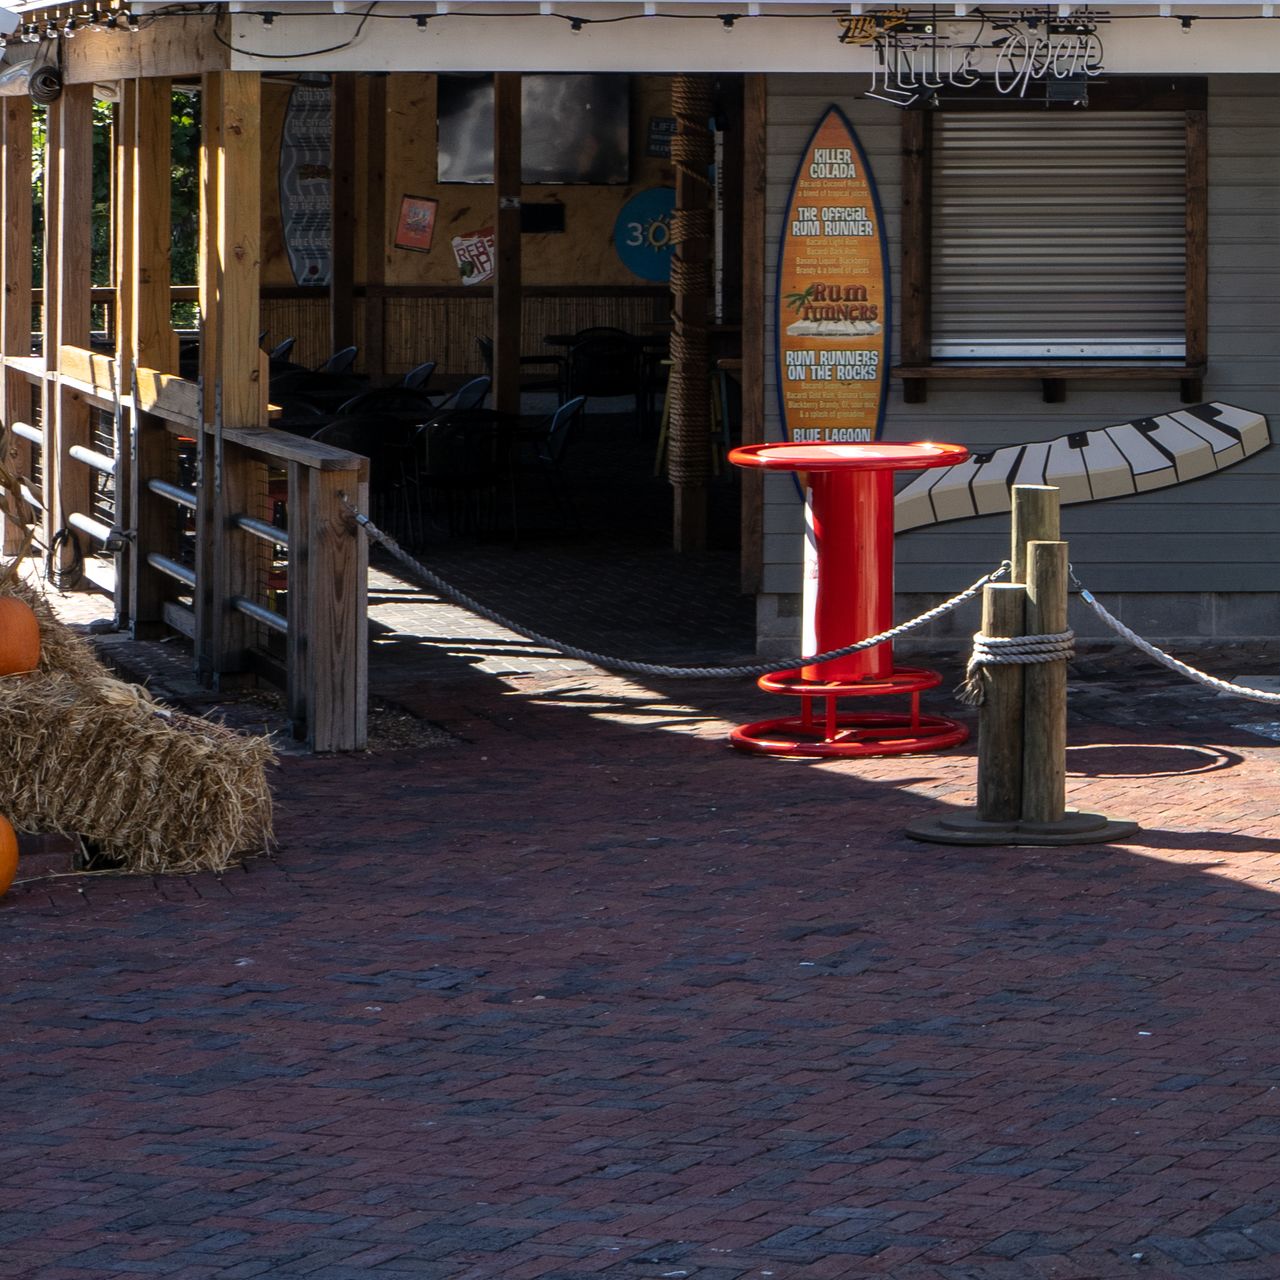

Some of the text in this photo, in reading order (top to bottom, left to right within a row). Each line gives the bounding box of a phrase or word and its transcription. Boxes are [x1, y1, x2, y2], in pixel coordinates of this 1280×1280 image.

[995, 34, 1104, 99] Open
[814, 148, 852, 163] KILLER
[810, 164, 856, 179] COLADA
[792, 221, 873, 236] RUM RUNNER
[812, 282, 868, 302] Rum
[786, 350, 879, 365] RUM RUNNERS
[788, 365, 876, 380] ON THE ROCKS
[793, 428, 871, 442] BLUE LAGOON
